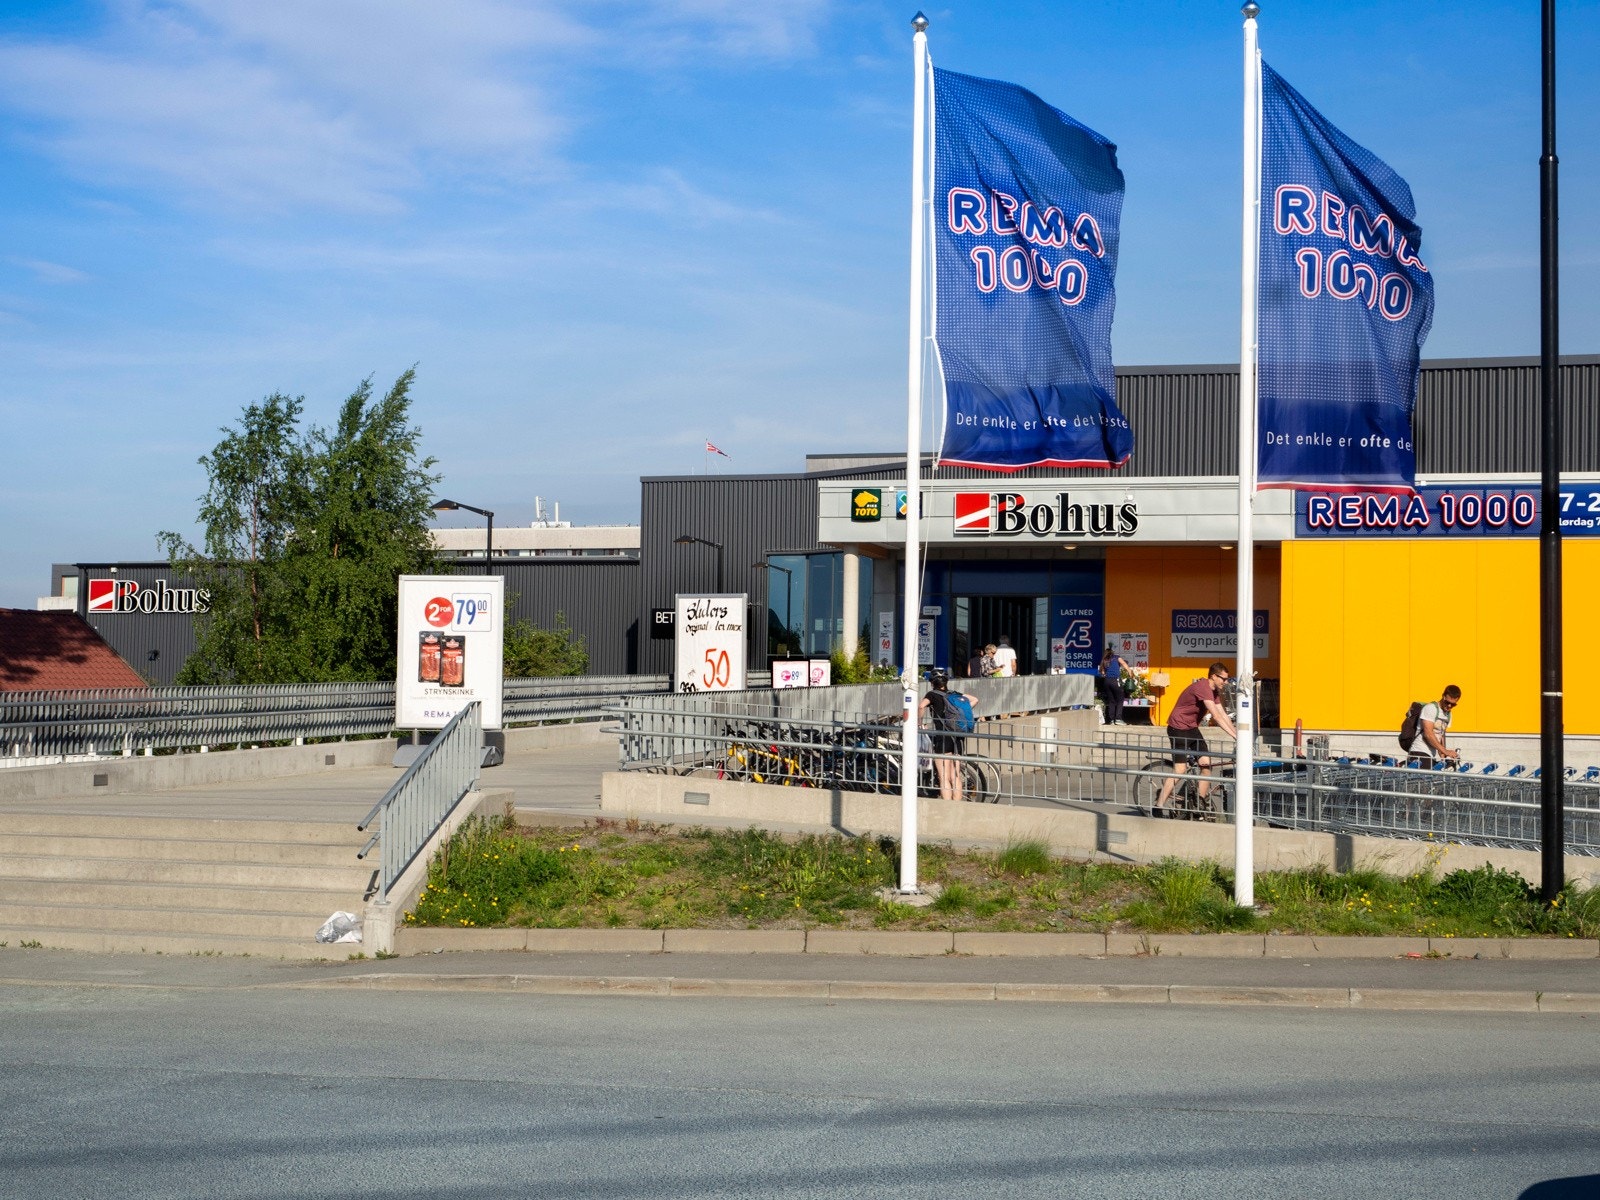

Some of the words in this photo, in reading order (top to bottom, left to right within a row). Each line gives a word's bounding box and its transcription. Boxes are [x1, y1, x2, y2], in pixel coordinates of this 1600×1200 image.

[949, 187, 1105, 258] REMA
[956, 412, 978, 427] Det
[982, 415, 1017, 430] enkle
[1023, 418, 1037, 431] er
[1043, 415, 1067, 429] fte
[1073, 413, 1096, 428] det
[1266, 431, 1290, 446] Det
[1296, 431, 1333, 447] enkle
[1338, 437, 1352, 447] er
[1360, 434, 1391, 448] ofte
[855, 507, 879, 517] TOTO
[992, 492, 1139, 535] Bohus
[1307, 494, 1432, 528] REMA
[1438, 494, 1537, 528] 1000
[114, 579, 212, 614] Bohus
[428, 603, 440, 622] 2
[1176, 614, 1224, 628] REMA
[1227, 615, 1264, 629] 10
[1063, 619, 1092, 648] Æ
[1065, 660, 1093, 669] ENGER
[1073, 652, 1093, 660] SPAR
[703, 648, 731, 689] 50
[424, 688, 475, 696] STRYNSKINKE
[424, 710, 451, 718] REMA
